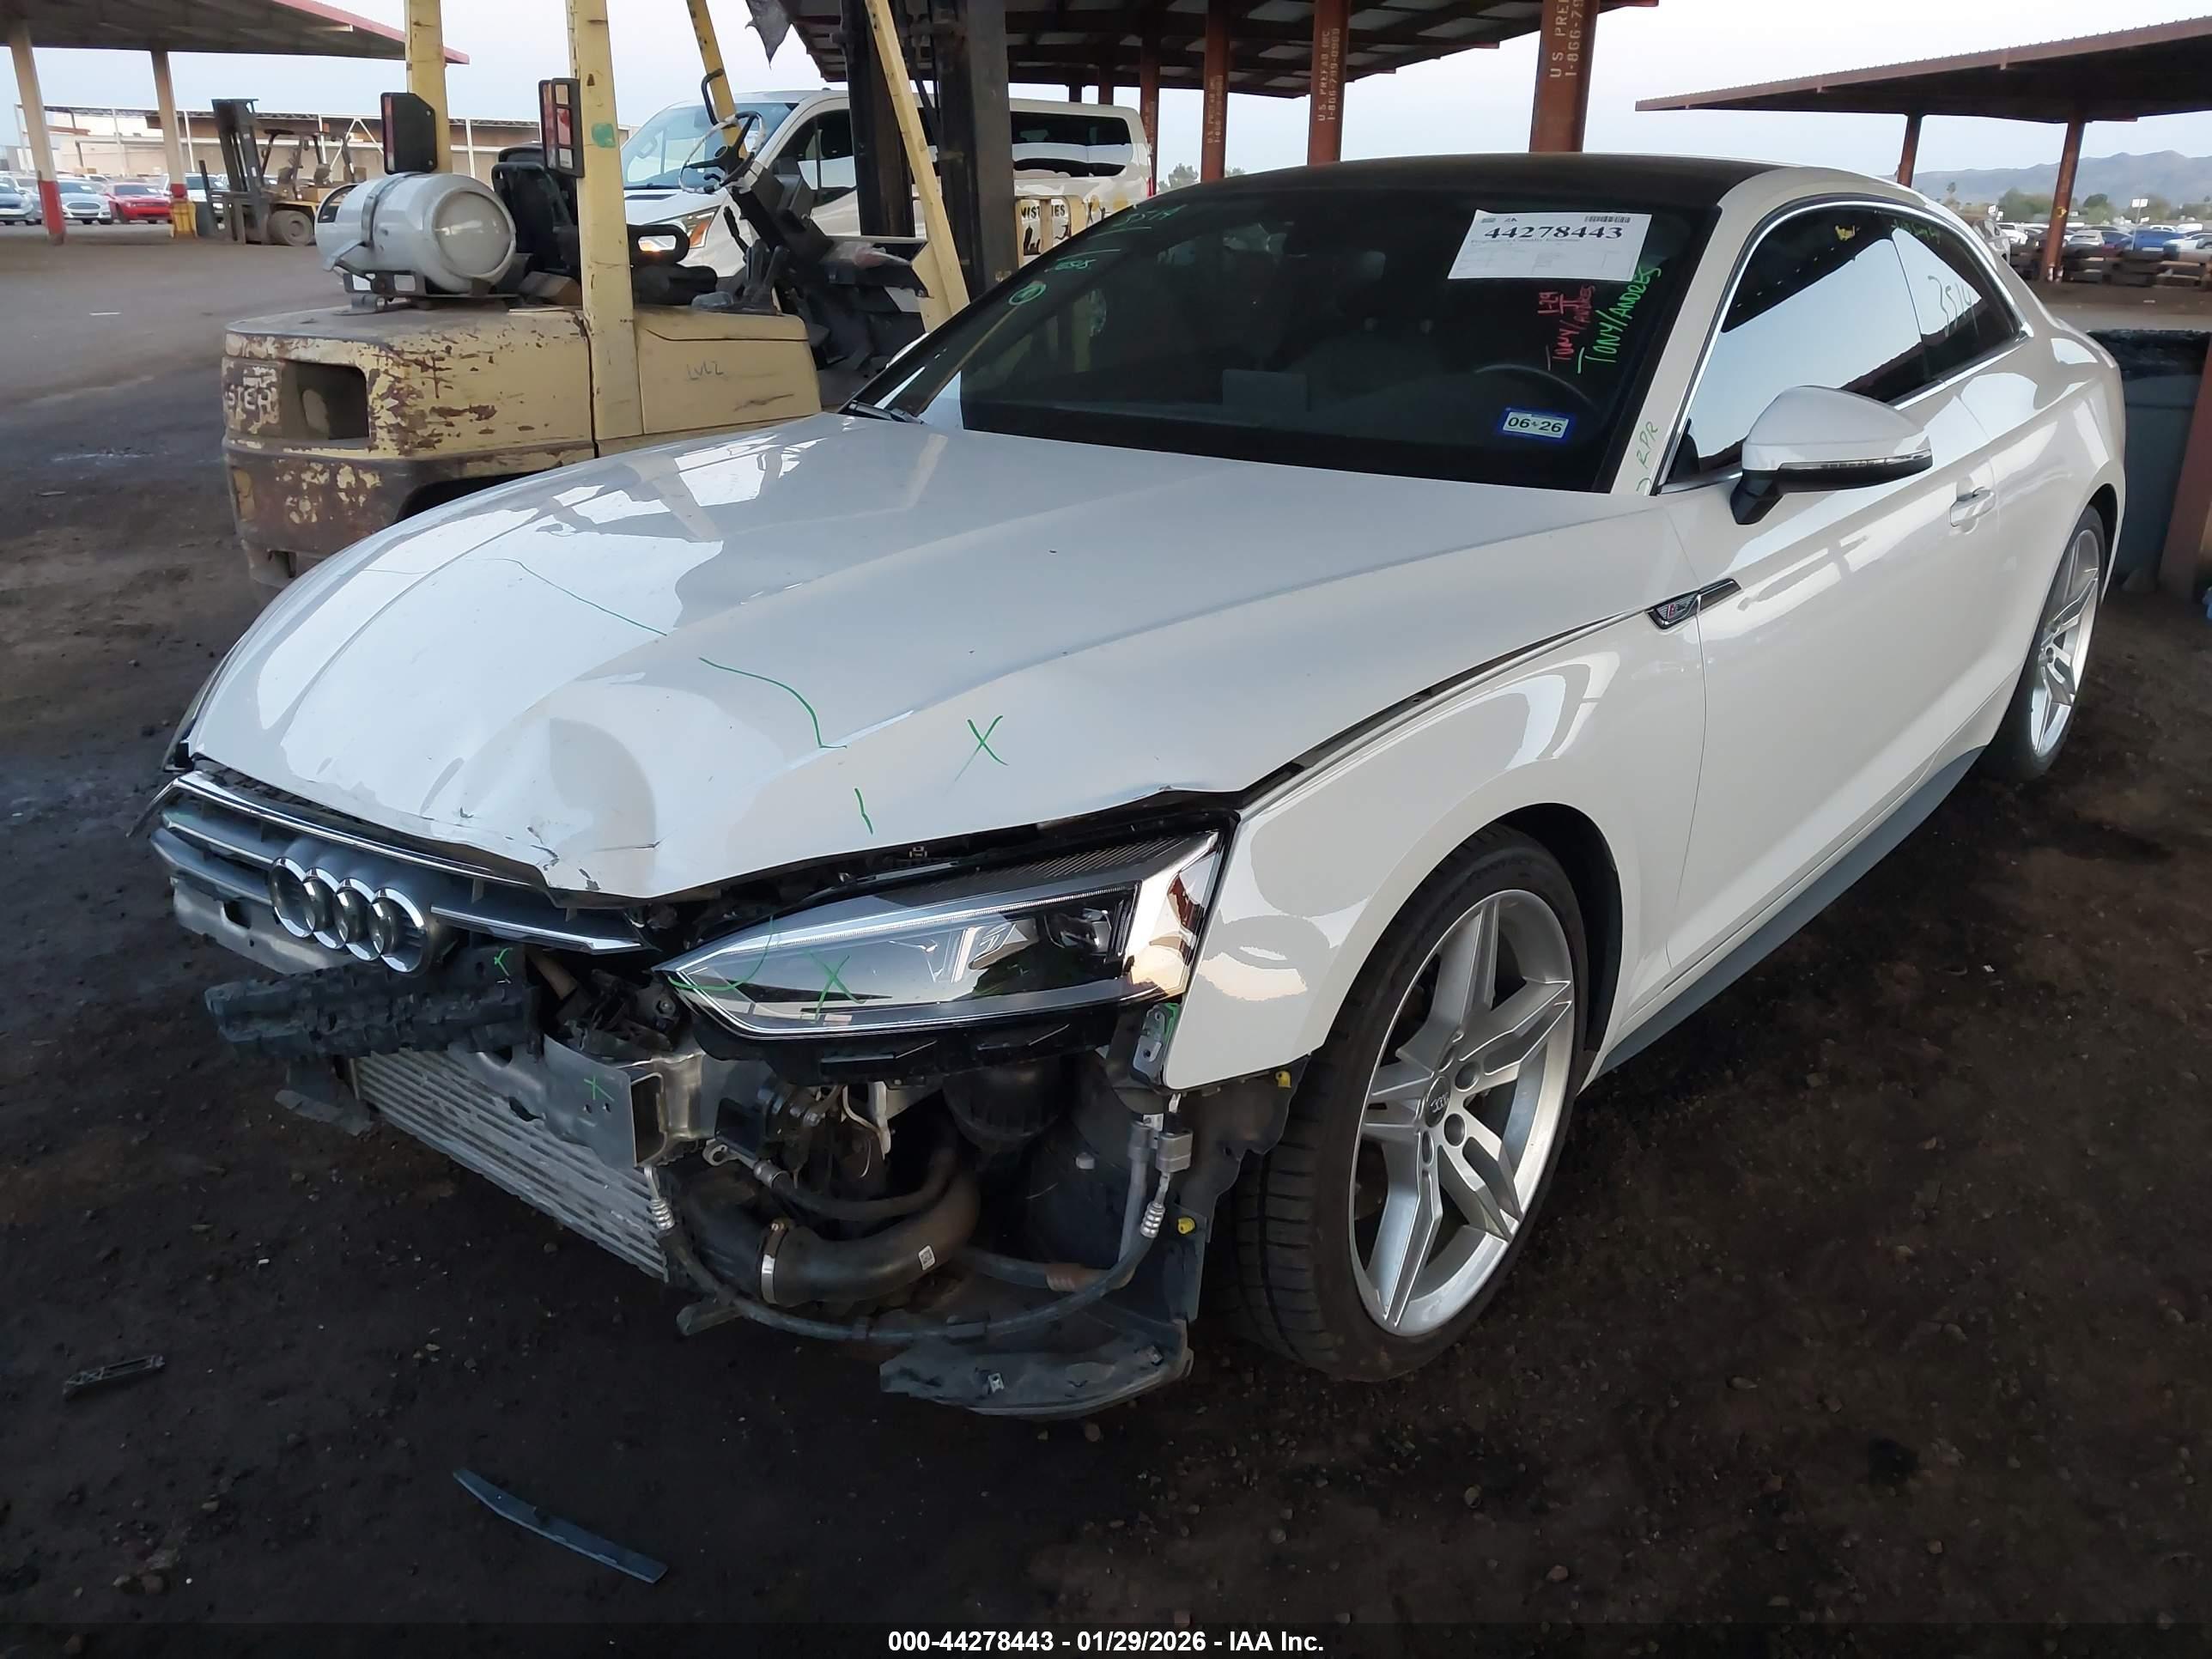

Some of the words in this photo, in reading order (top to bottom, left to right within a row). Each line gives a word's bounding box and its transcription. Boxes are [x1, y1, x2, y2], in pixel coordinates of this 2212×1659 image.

[1484, 226, 1623, 240] 44278443
[1577, 264, 1662, 374] TONY/ANDRES
[1507, 416, 1531, 428] 06
[1538, 420, 1564, 433] 26
